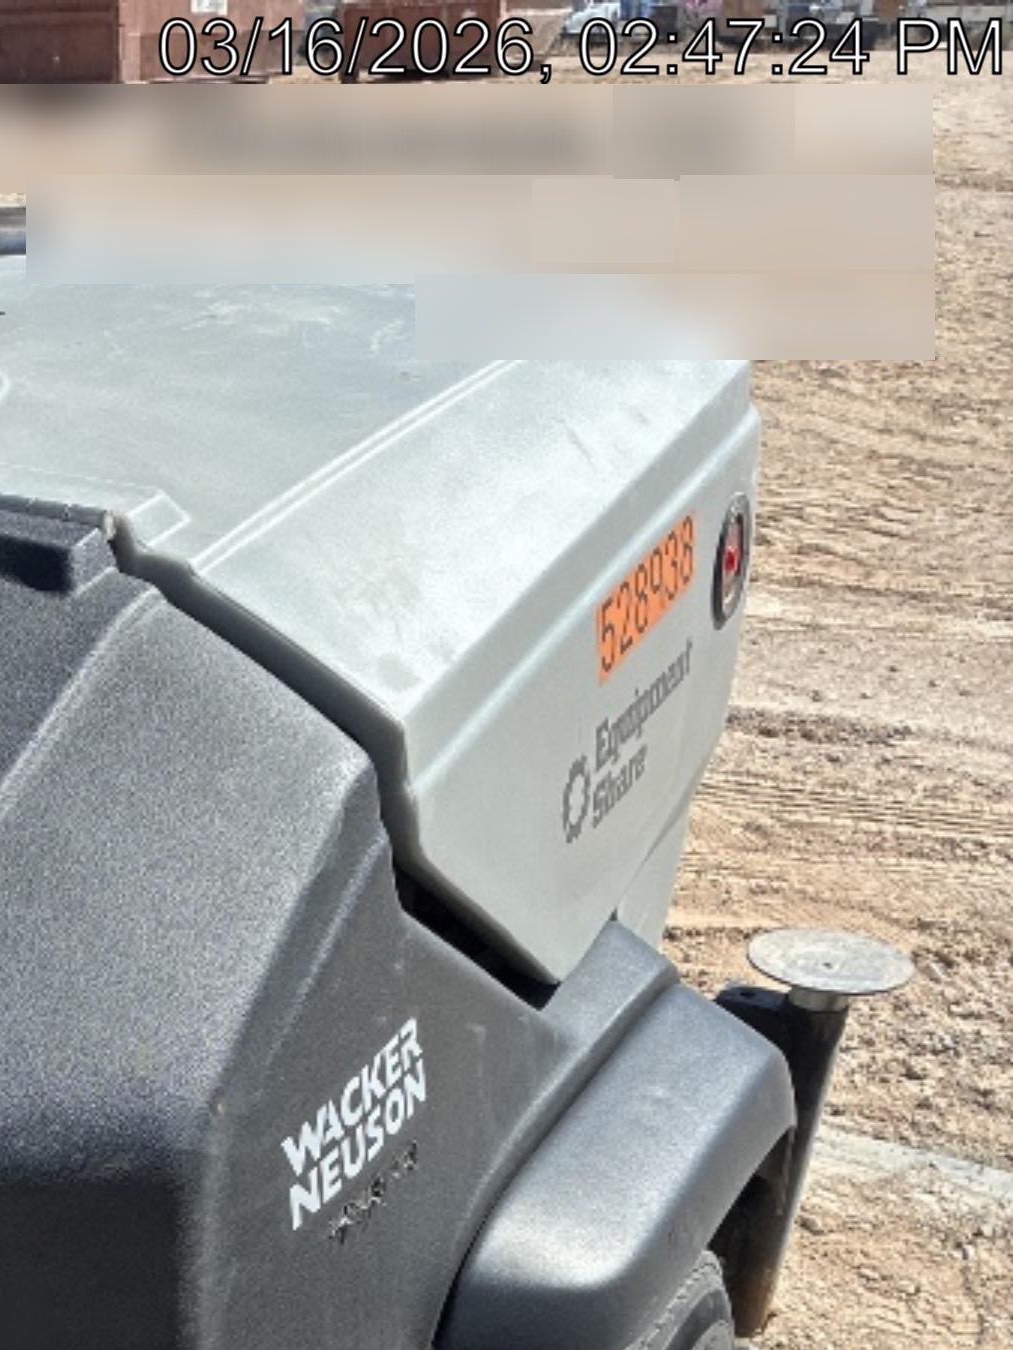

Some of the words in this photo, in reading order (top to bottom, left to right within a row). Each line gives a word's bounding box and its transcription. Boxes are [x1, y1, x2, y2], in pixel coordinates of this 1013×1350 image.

[599, 513, 694, 674] 528938
[595, 636, 694, 773] Equipment
[592, 744, 649, 830] Share
[280, 1016, 424, 1177] WACKER
[289, 1058, 427, 1232] NEUSON
